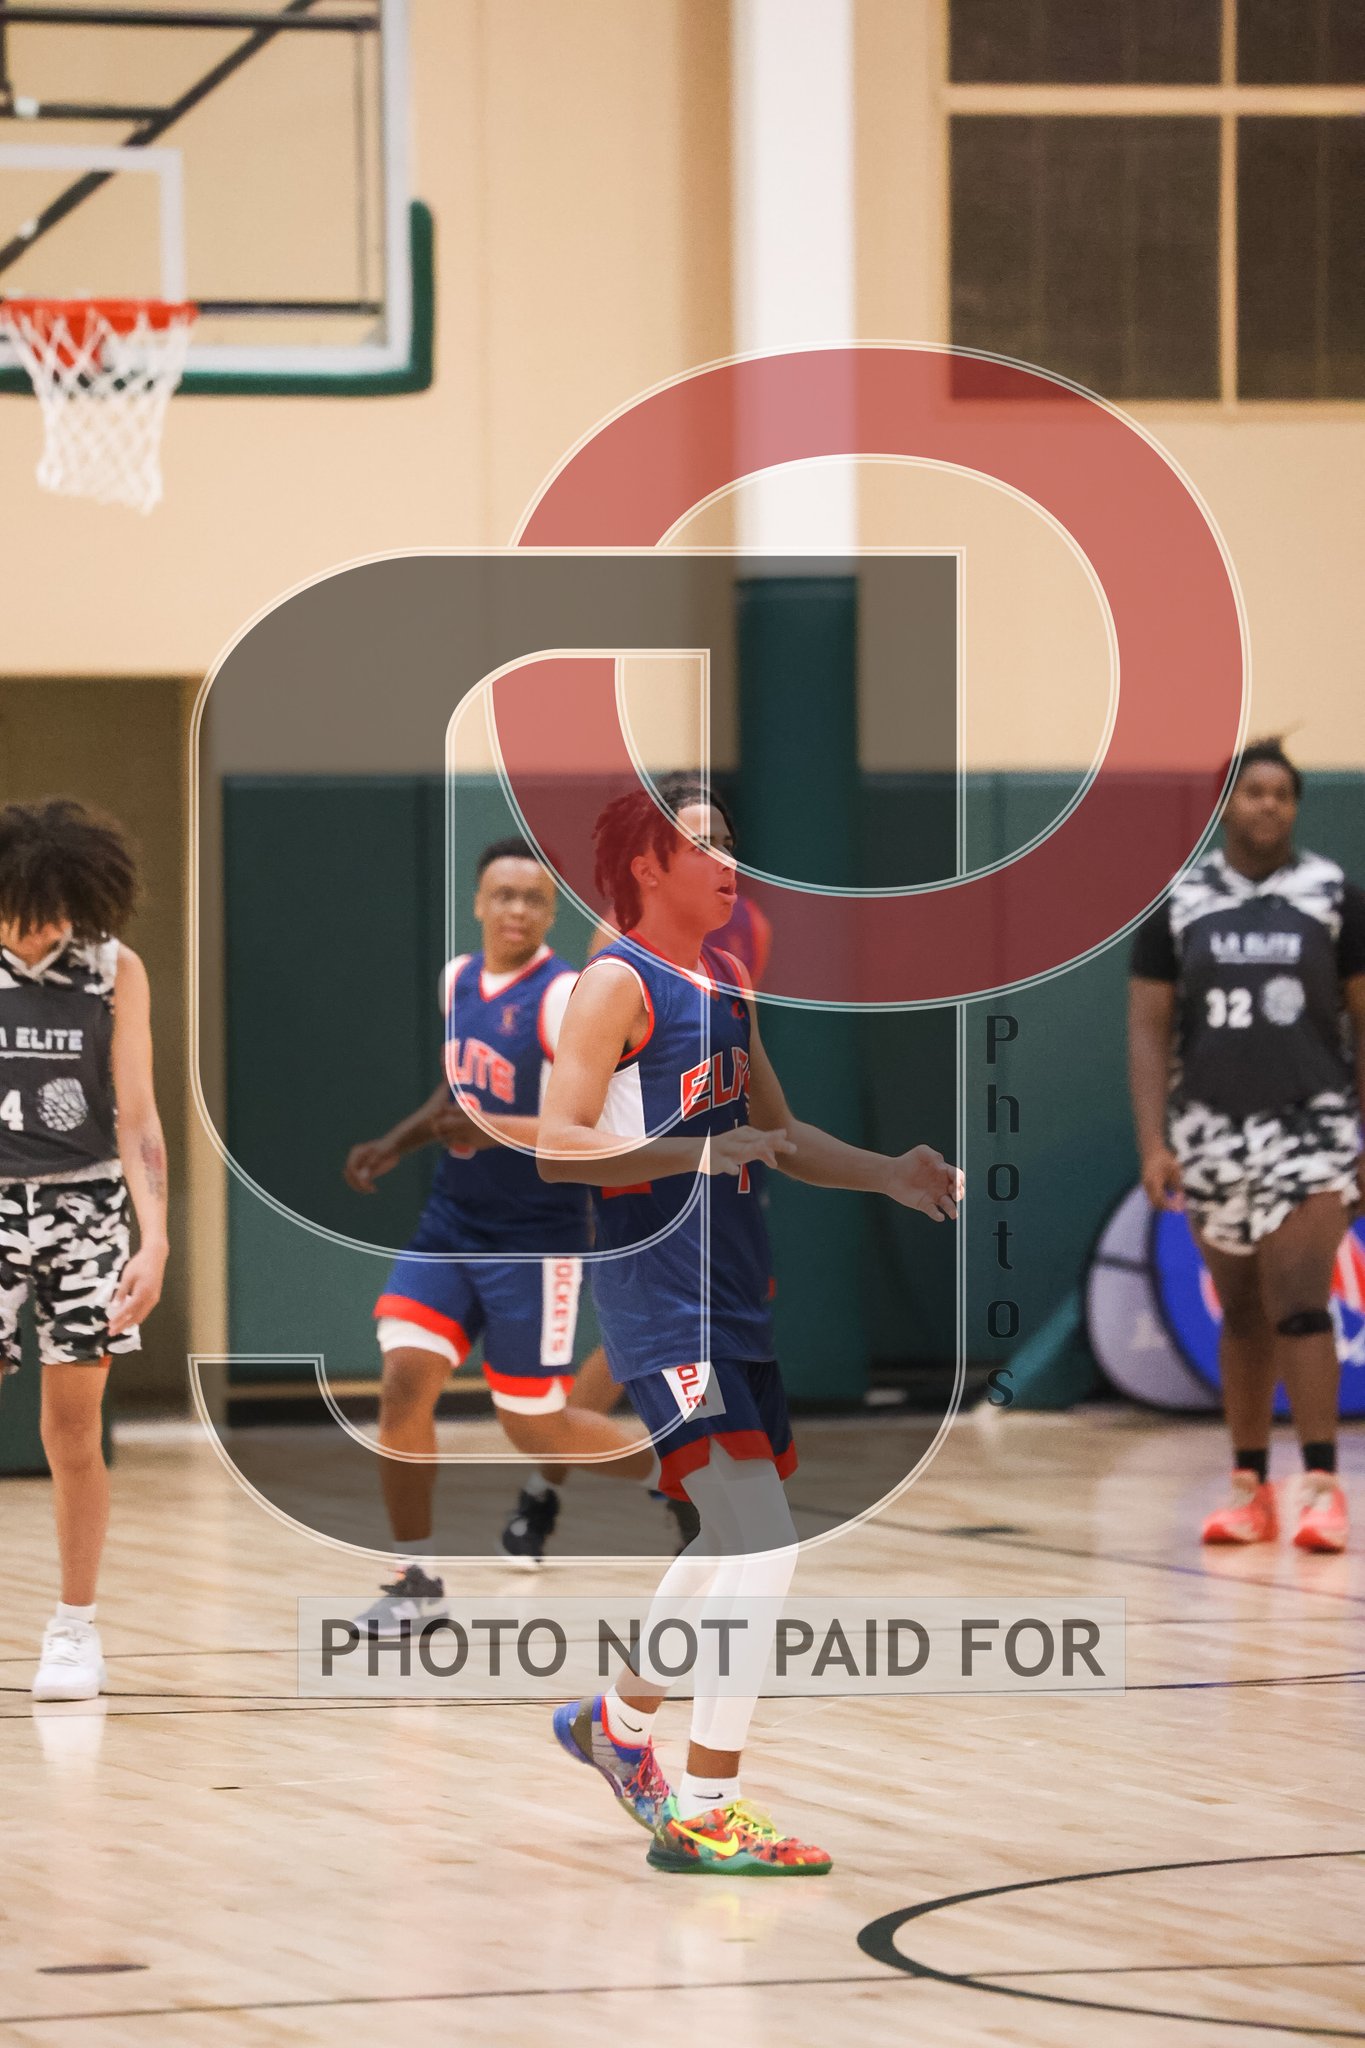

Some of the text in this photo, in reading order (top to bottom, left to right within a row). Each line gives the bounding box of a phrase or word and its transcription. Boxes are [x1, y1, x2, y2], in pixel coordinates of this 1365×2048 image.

[16, 1026, 84, 1051] ELITE
[0, 1089, 24, 1131] 4
[552, 1257, 574, 1352] OCKETS
